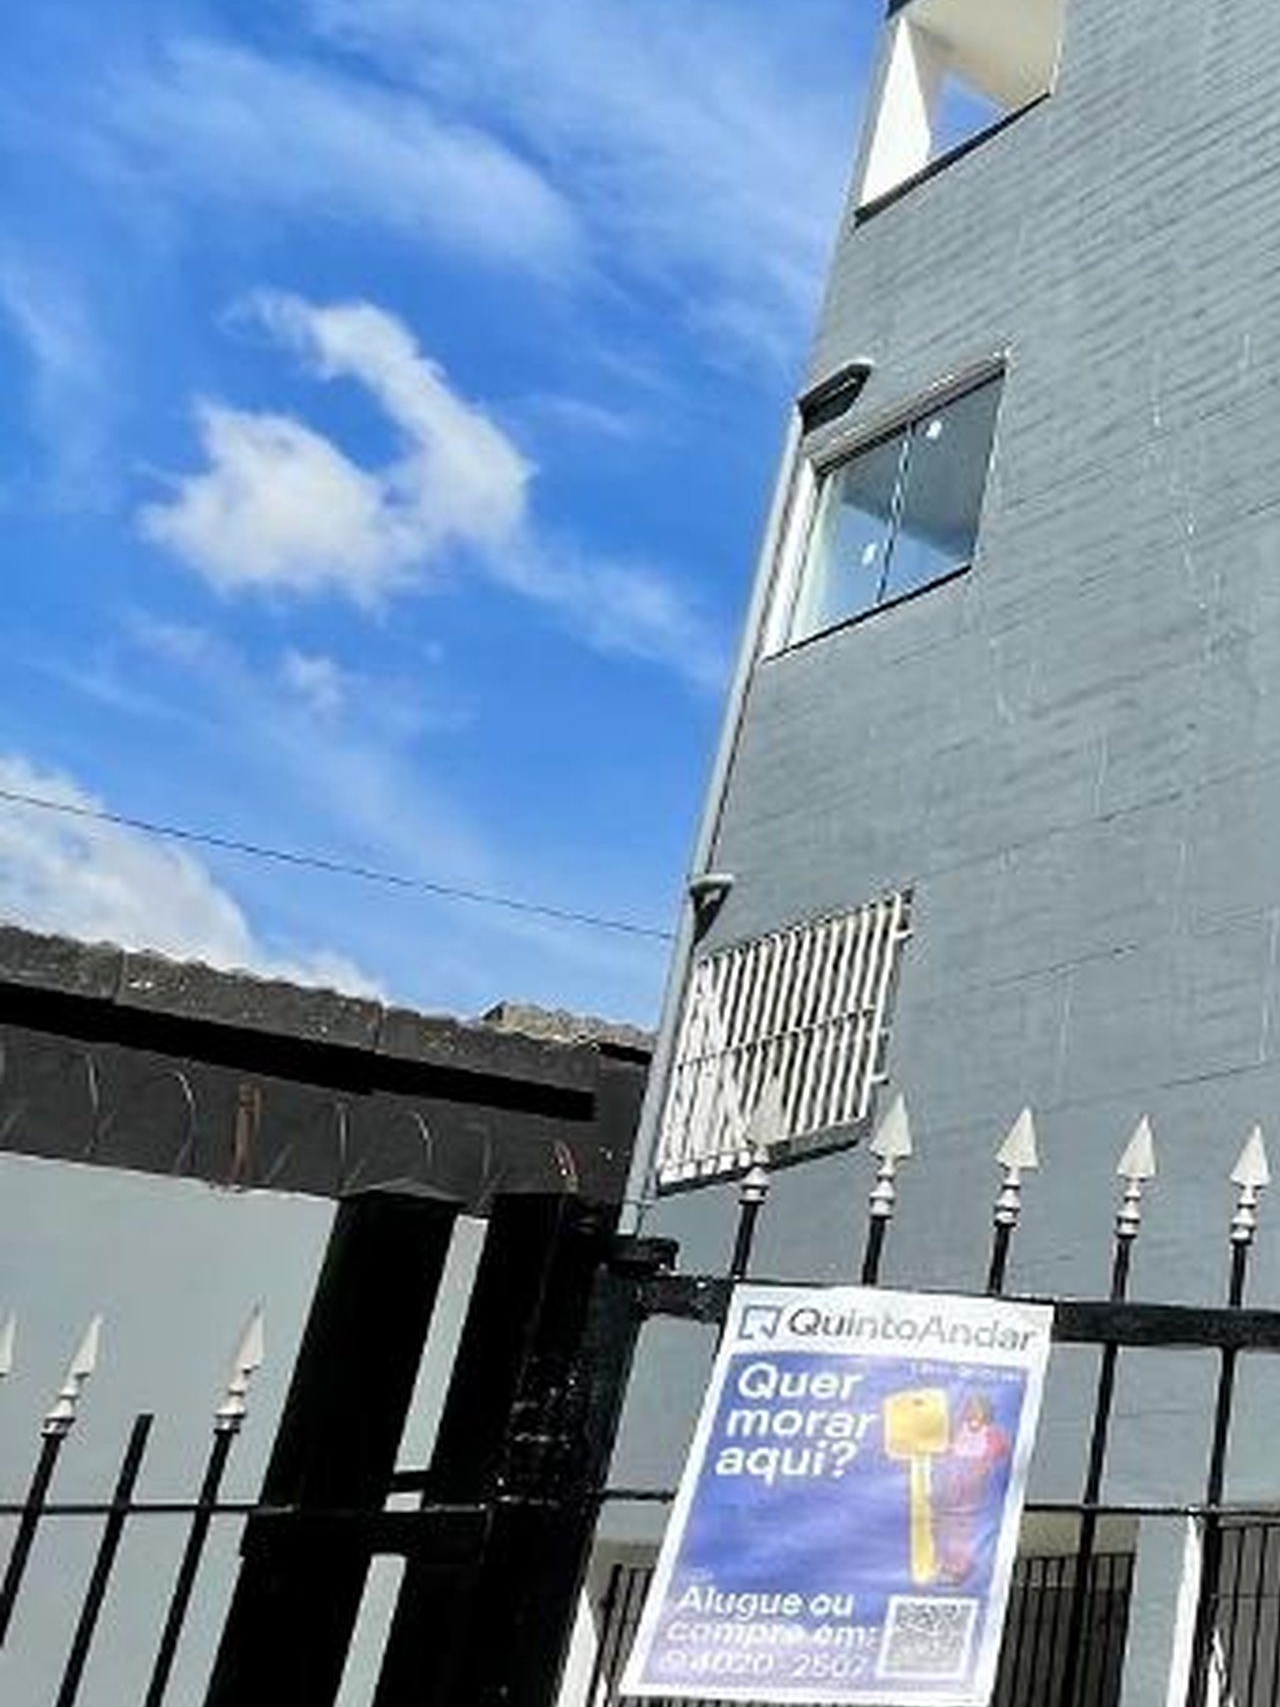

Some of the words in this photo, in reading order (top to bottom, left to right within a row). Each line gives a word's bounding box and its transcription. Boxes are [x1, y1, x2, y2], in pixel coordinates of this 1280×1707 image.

[788, 1307, 1036, 1351] QuintoAndar
[736, 1361, 862, 1401] Quer
[725, 1407, 878, 1439] morar
[714, 1441, 858, 1484] aqui?
[677, 1586, 803, 1622] Alugue
[808, 1593, 855, 1617] ou
[665, 1620, 808, 1650] compre
